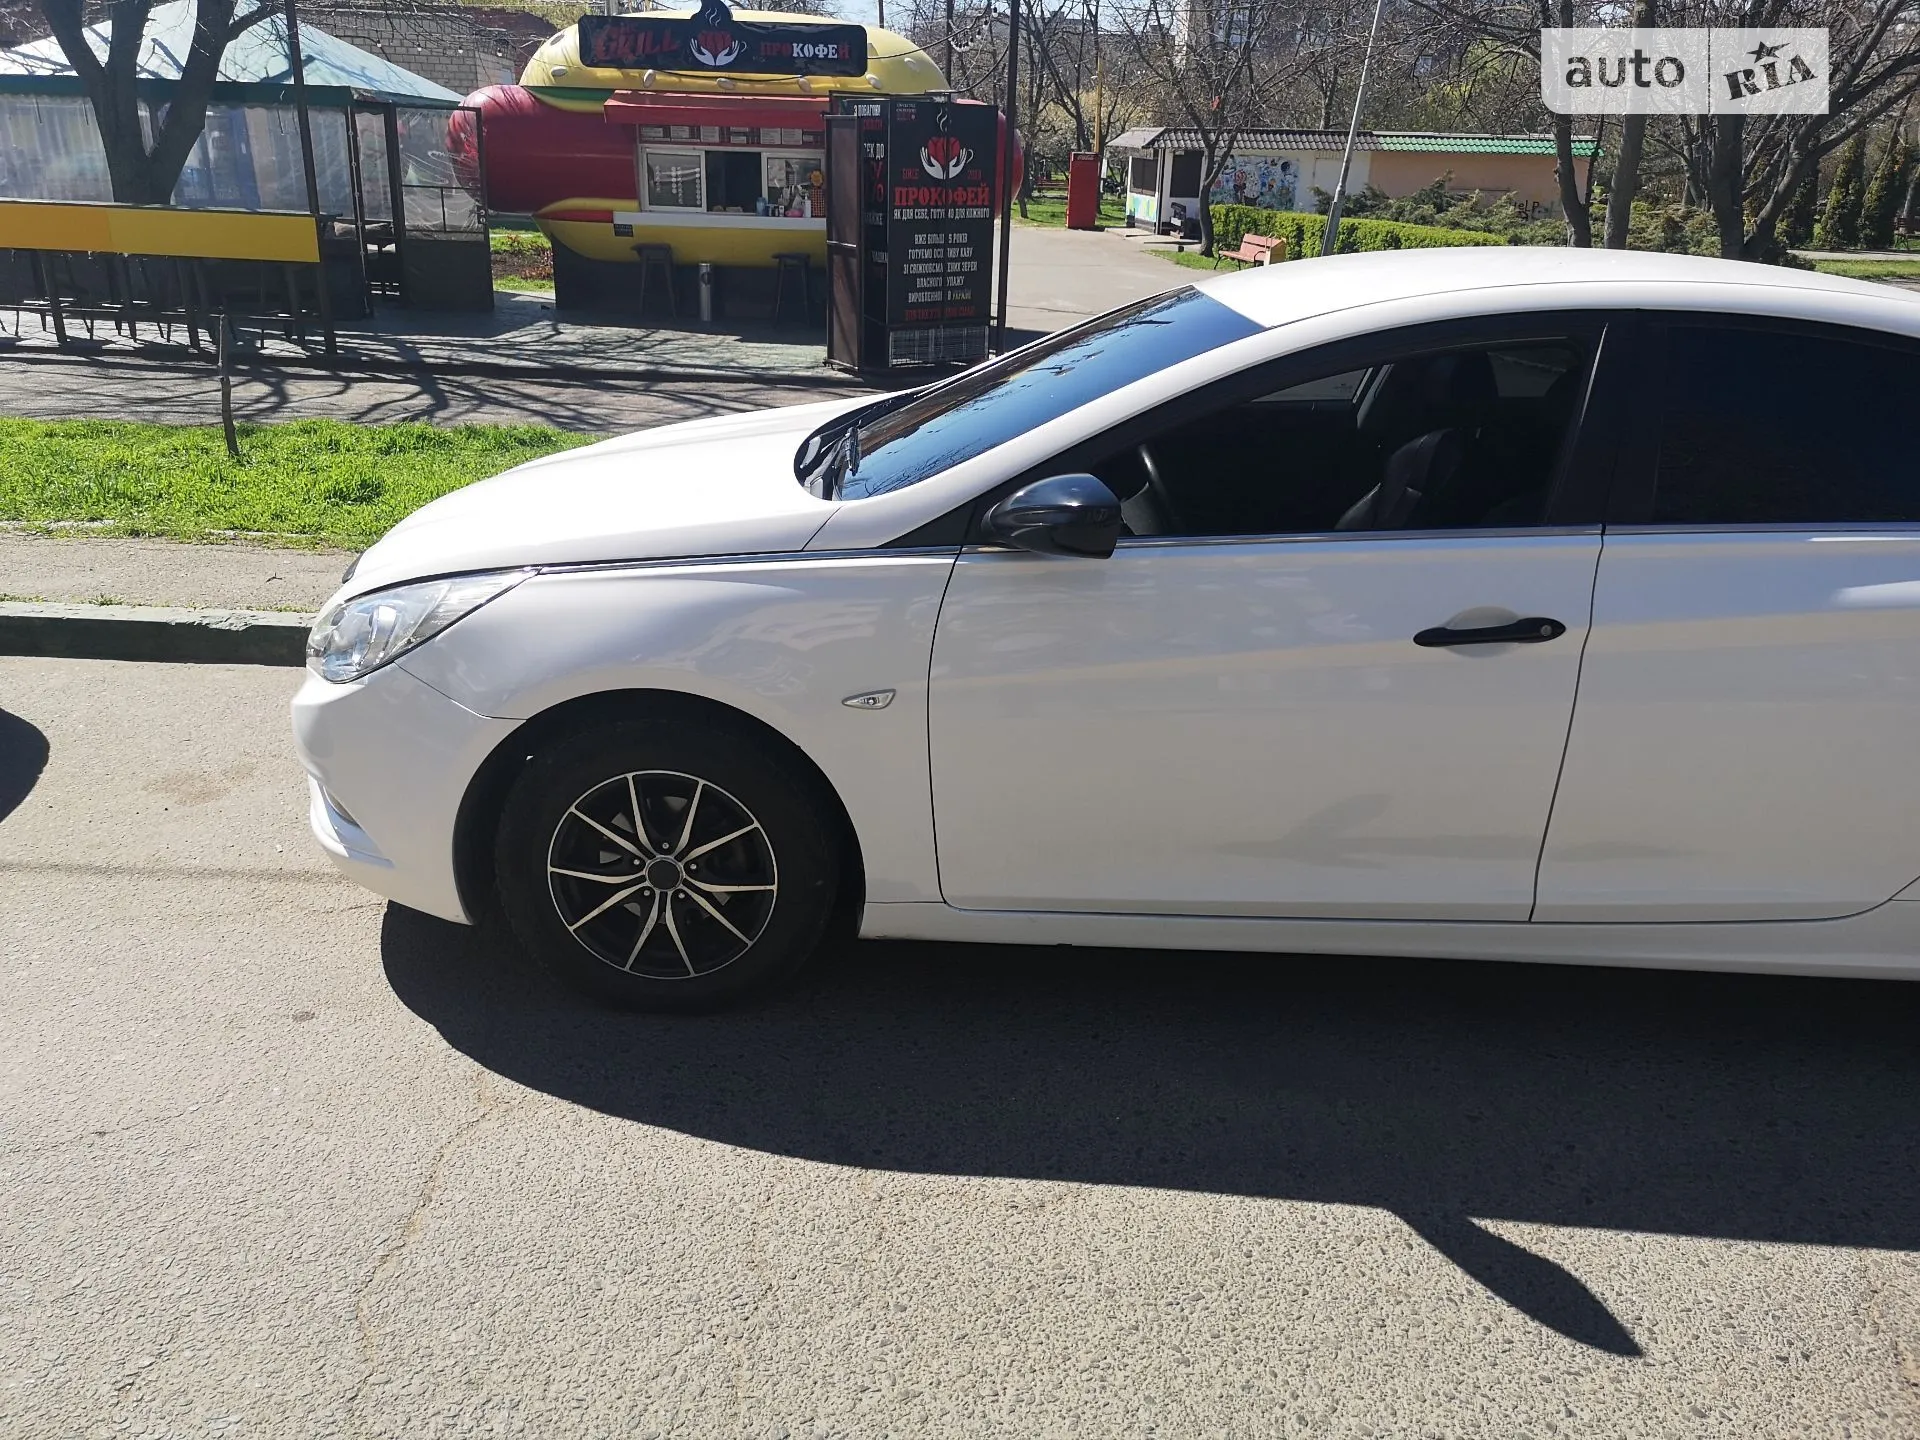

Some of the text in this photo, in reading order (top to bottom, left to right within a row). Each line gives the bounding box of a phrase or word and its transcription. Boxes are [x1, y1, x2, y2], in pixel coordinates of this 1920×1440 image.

[893, 208, 901, 219] ЯК
[902, 208, 913, 221] ДЛЯ
[954, 208, 965, 220] ДЛЯ
[966, 207, 990, 218] КОЖНОГО
[914, 234, 926, 244] ВЖЕ
[953, 232, 968, 243] РОКІВ
[961, 261, 978, 271] ЗЕРЕН
